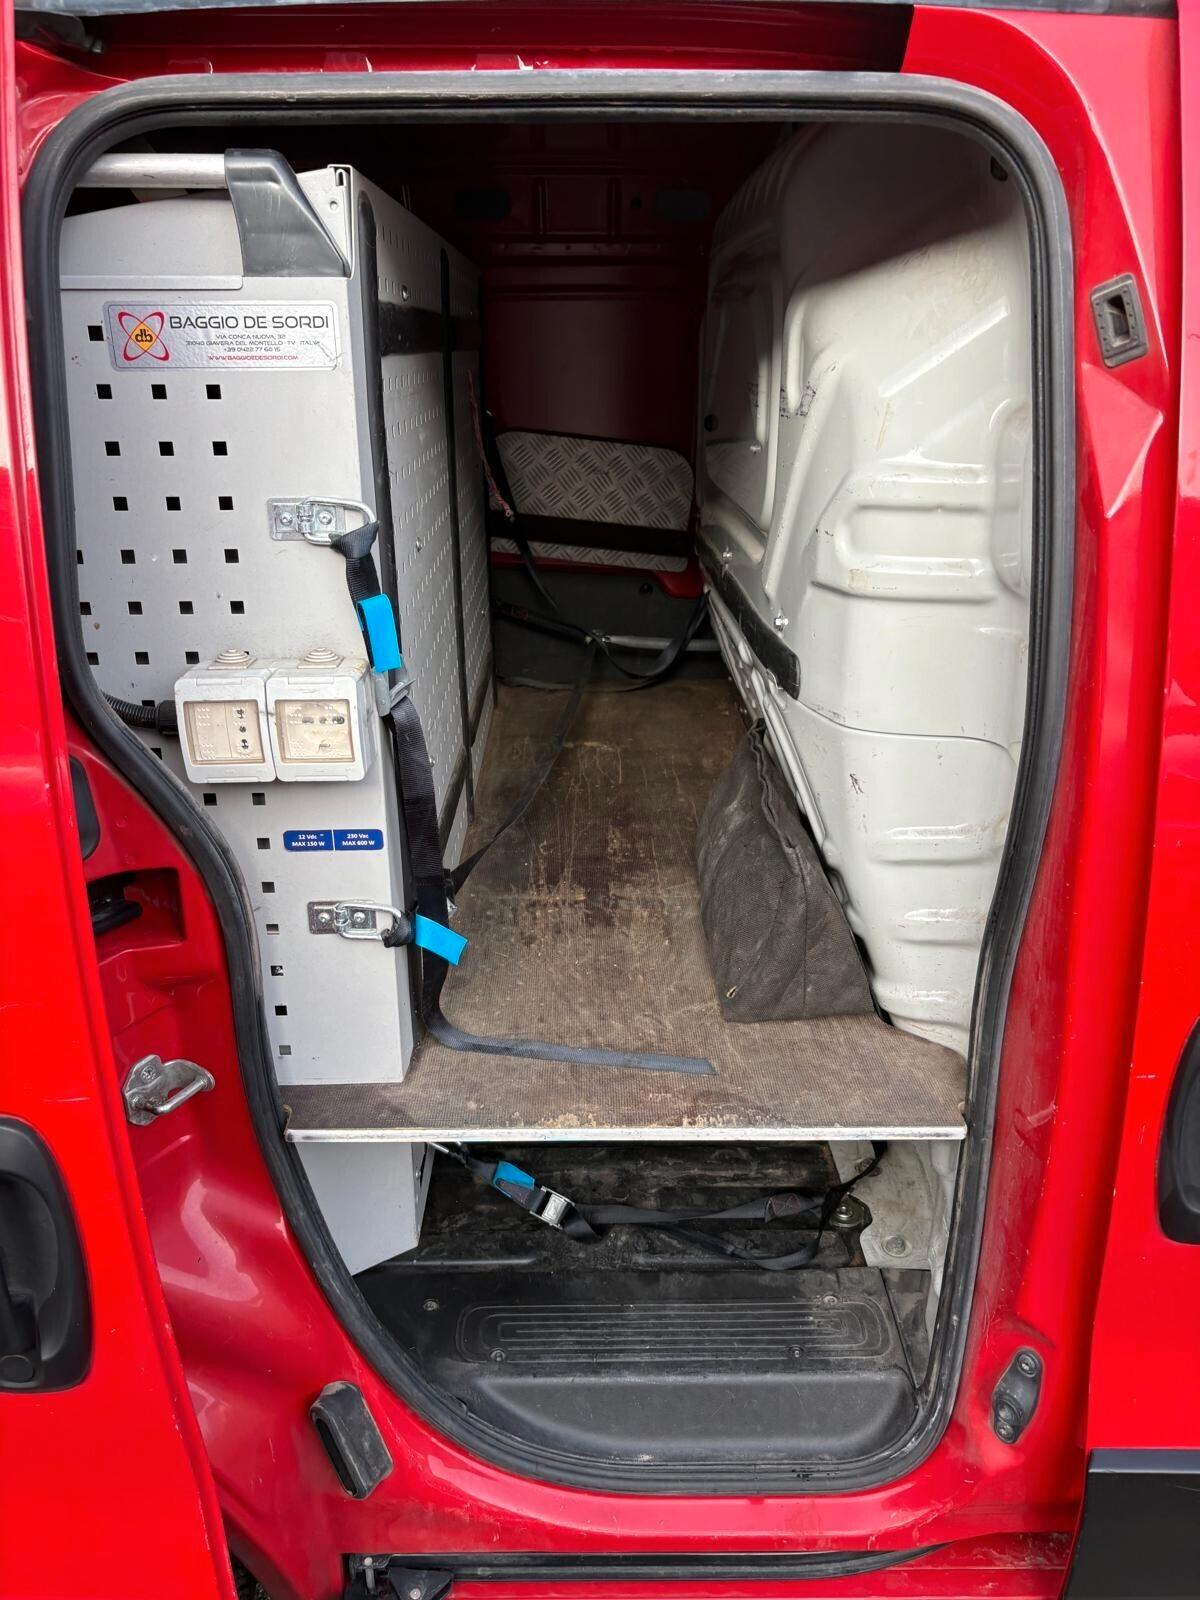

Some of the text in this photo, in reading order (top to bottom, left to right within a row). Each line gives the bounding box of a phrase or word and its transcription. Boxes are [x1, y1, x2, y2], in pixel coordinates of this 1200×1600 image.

[169, 315, 329, 329] BAGGIO DE SORDI
